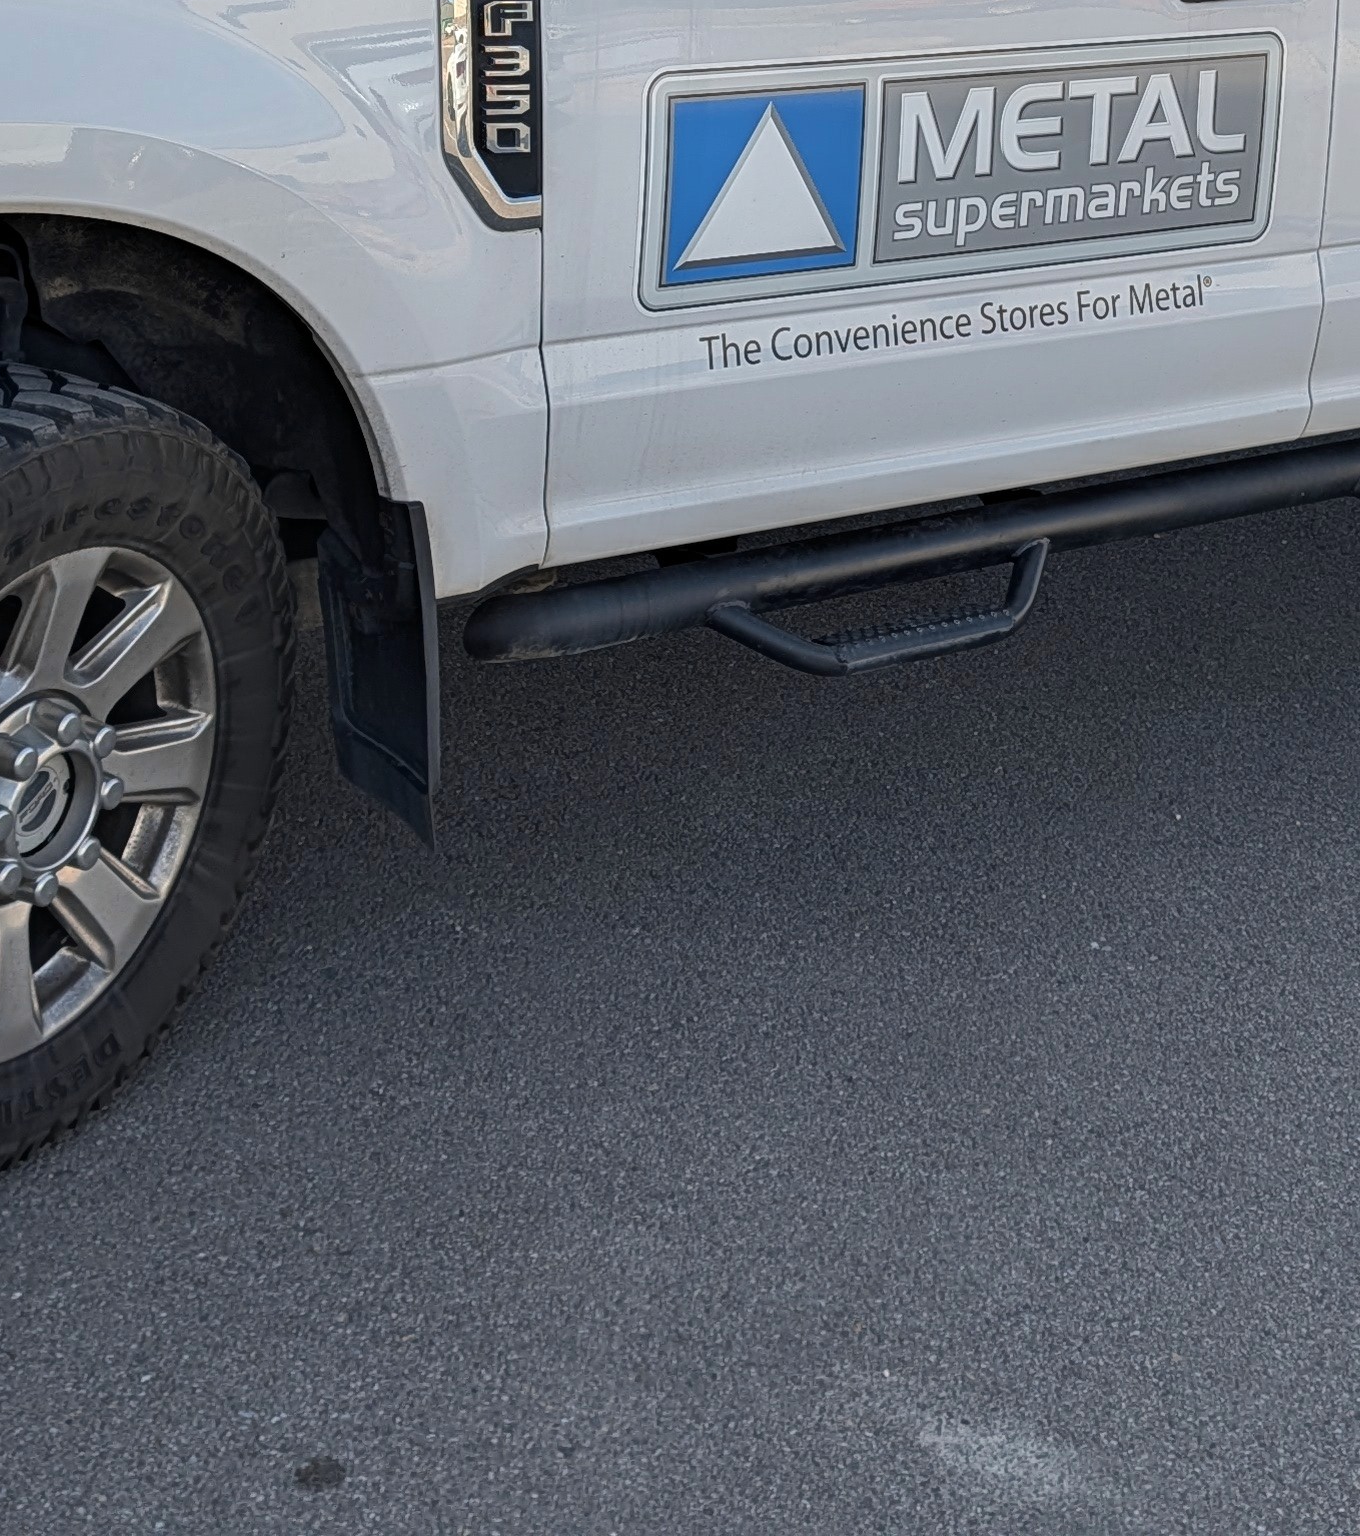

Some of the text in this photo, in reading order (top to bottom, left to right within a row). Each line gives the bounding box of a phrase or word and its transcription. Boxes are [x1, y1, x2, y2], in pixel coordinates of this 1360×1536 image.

[483, 0, 534, 154] F350
[898, 68, 1247, 184] METAL
[892, 161, 1242, 247] supermarkets
[700, 332, 762, 371] The
[771, 310, 972, 363] Convenience
[979, 298, 1070, 339] Stores
[1077, 288, 1121, 323] For
